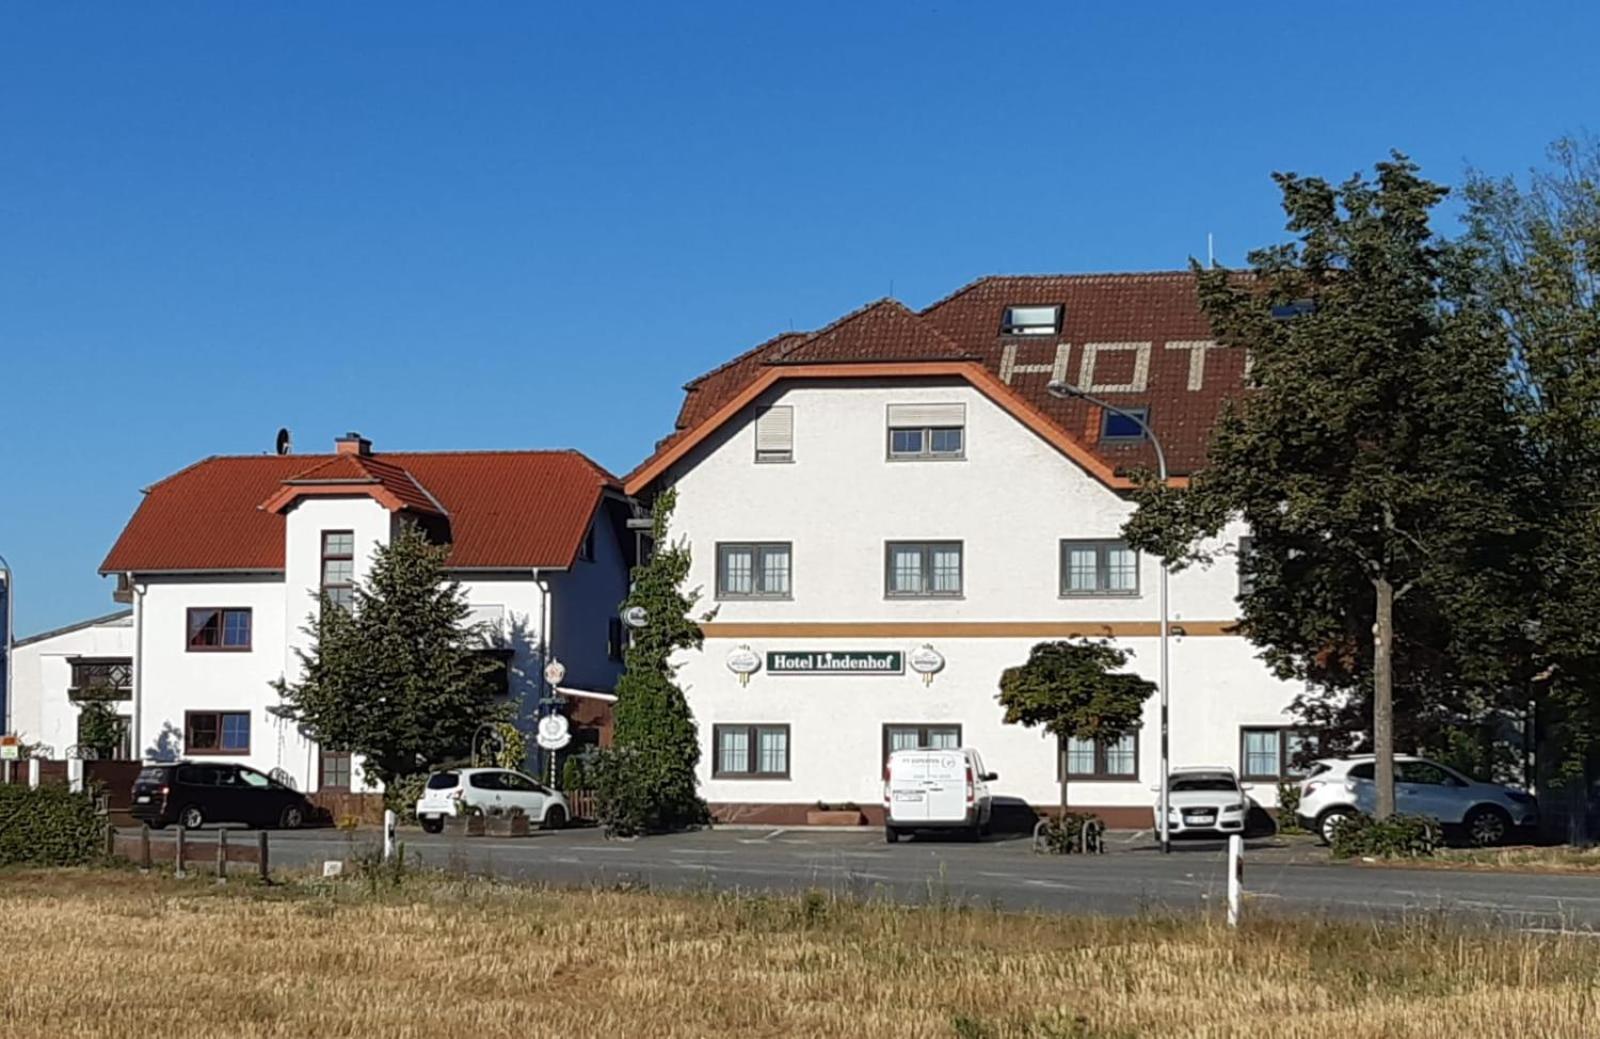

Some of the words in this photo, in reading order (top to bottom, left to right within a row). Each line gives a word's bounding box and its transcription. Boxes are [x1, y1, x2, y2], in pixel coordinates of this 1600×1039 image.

[999, 341, 1266, 392] HOT
[774, 655, 813, 669] Hotel
[816, 653, 894, 669] Lindenhof
